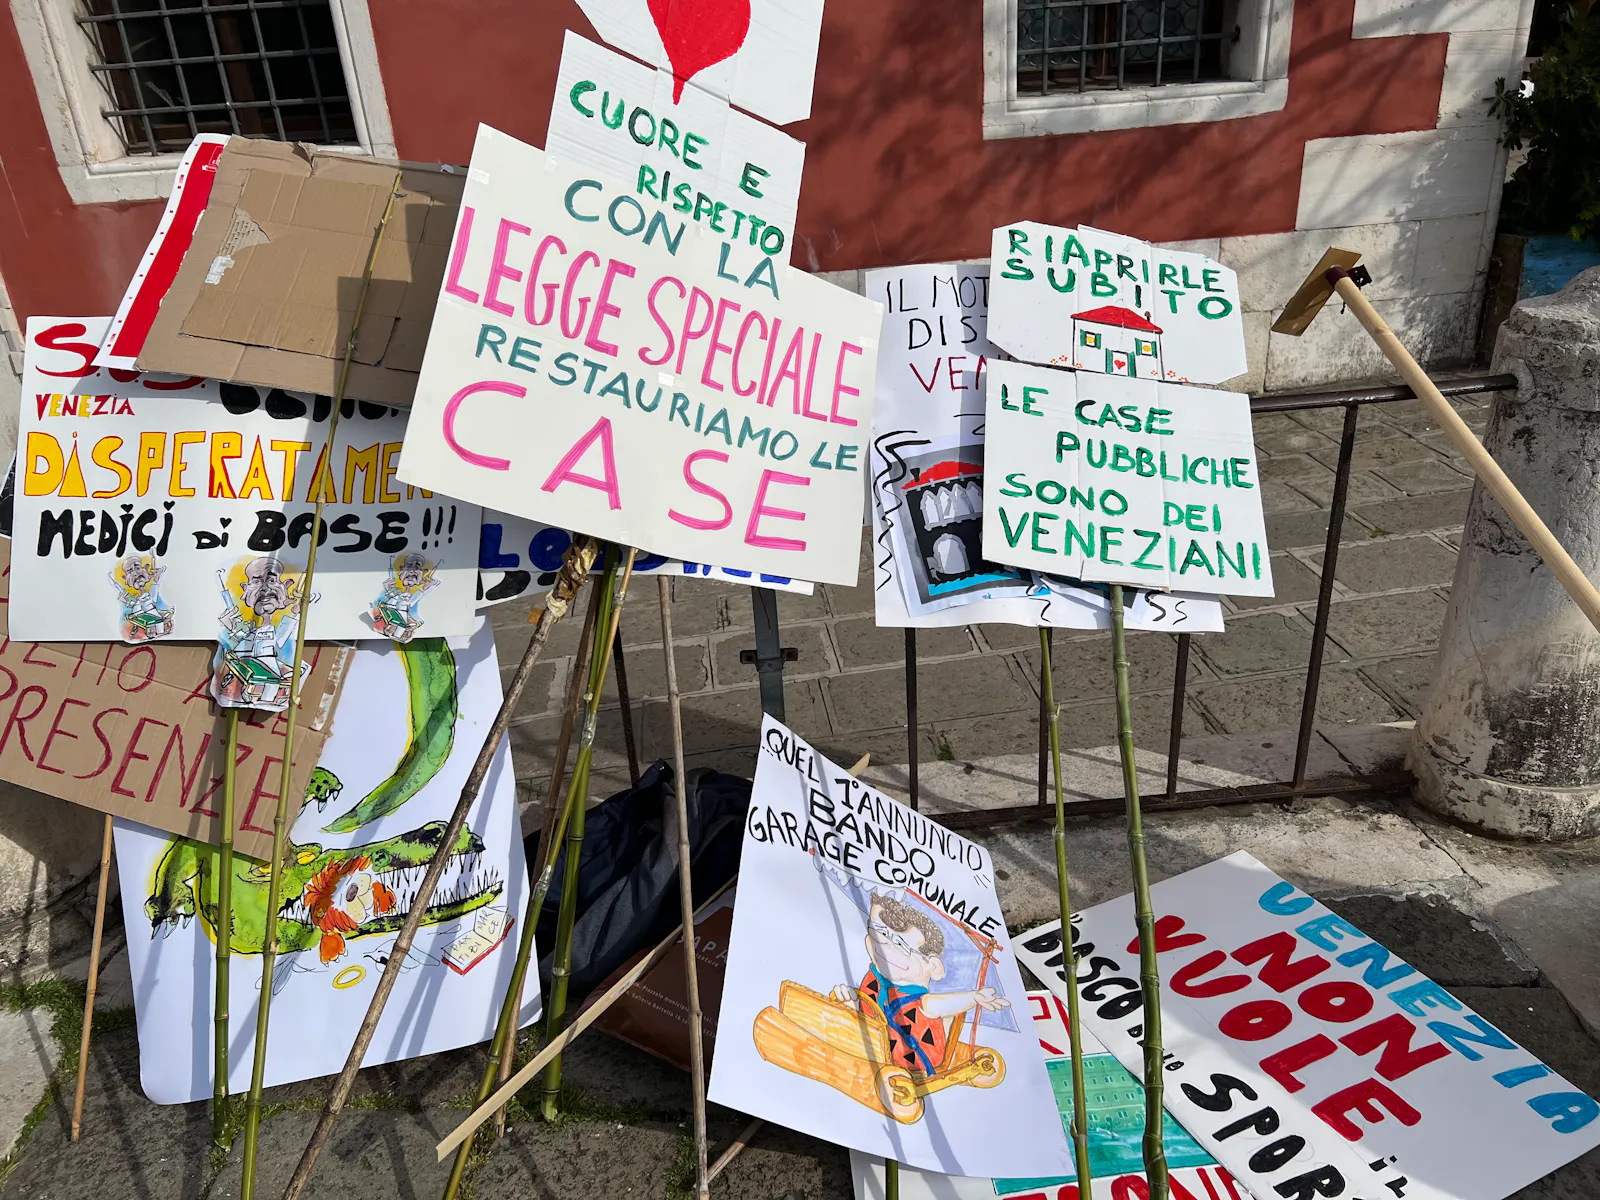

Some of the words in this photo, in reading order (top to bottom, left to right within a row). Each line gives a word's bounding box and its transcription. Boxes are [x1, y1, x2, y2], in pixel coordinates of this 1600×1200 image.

[569, 80, 710, 170] CUORE
[738, 162, 771, 198] E
[564, 179, 687, 256] CON
[717, 241, 780, 301] LA
[637, 164, 785, 256] RISPETTO
[886, 277, 919, 313] IL
[1000, 257, 1233, 320] SUBITO
[1008, 229, 1225, 293] RIAPRIRLE
[444, 205, 636, 358] LEGGE
[637, 276, 864, 426] SPECIALE
[908, 315, 988, 350] DIS
[475, 323, 800, 461] RESTAURIAMO
[809, 441, 859, 472] LE
[1001, 384, 1049, 417] LE
[1075, 399, 1174, 435] CASE
[442, 379, 812, 552] CASE
[999, 473, 1129, 517] SONO
[1163, 501, 1222, 535] DEI
[1056, 431, 1255, 489] PUBBLICHE
[998, 506, 1262, 581] VENEZIANI
[748, 806, 864, 873] GARAGE
[874, 859, 1002, 938] COMUNALE
[809, 787, 936, 878] BANDO
[857, 790, 983, 871] ANNUNCIO
[664, 996, 691, 1012] municipi
[1125, 914, 1423, 1142] VUOLE
[1230, 930, 1452, 1082] NON
[1180, 1073, 1362, 1200] SPOR
